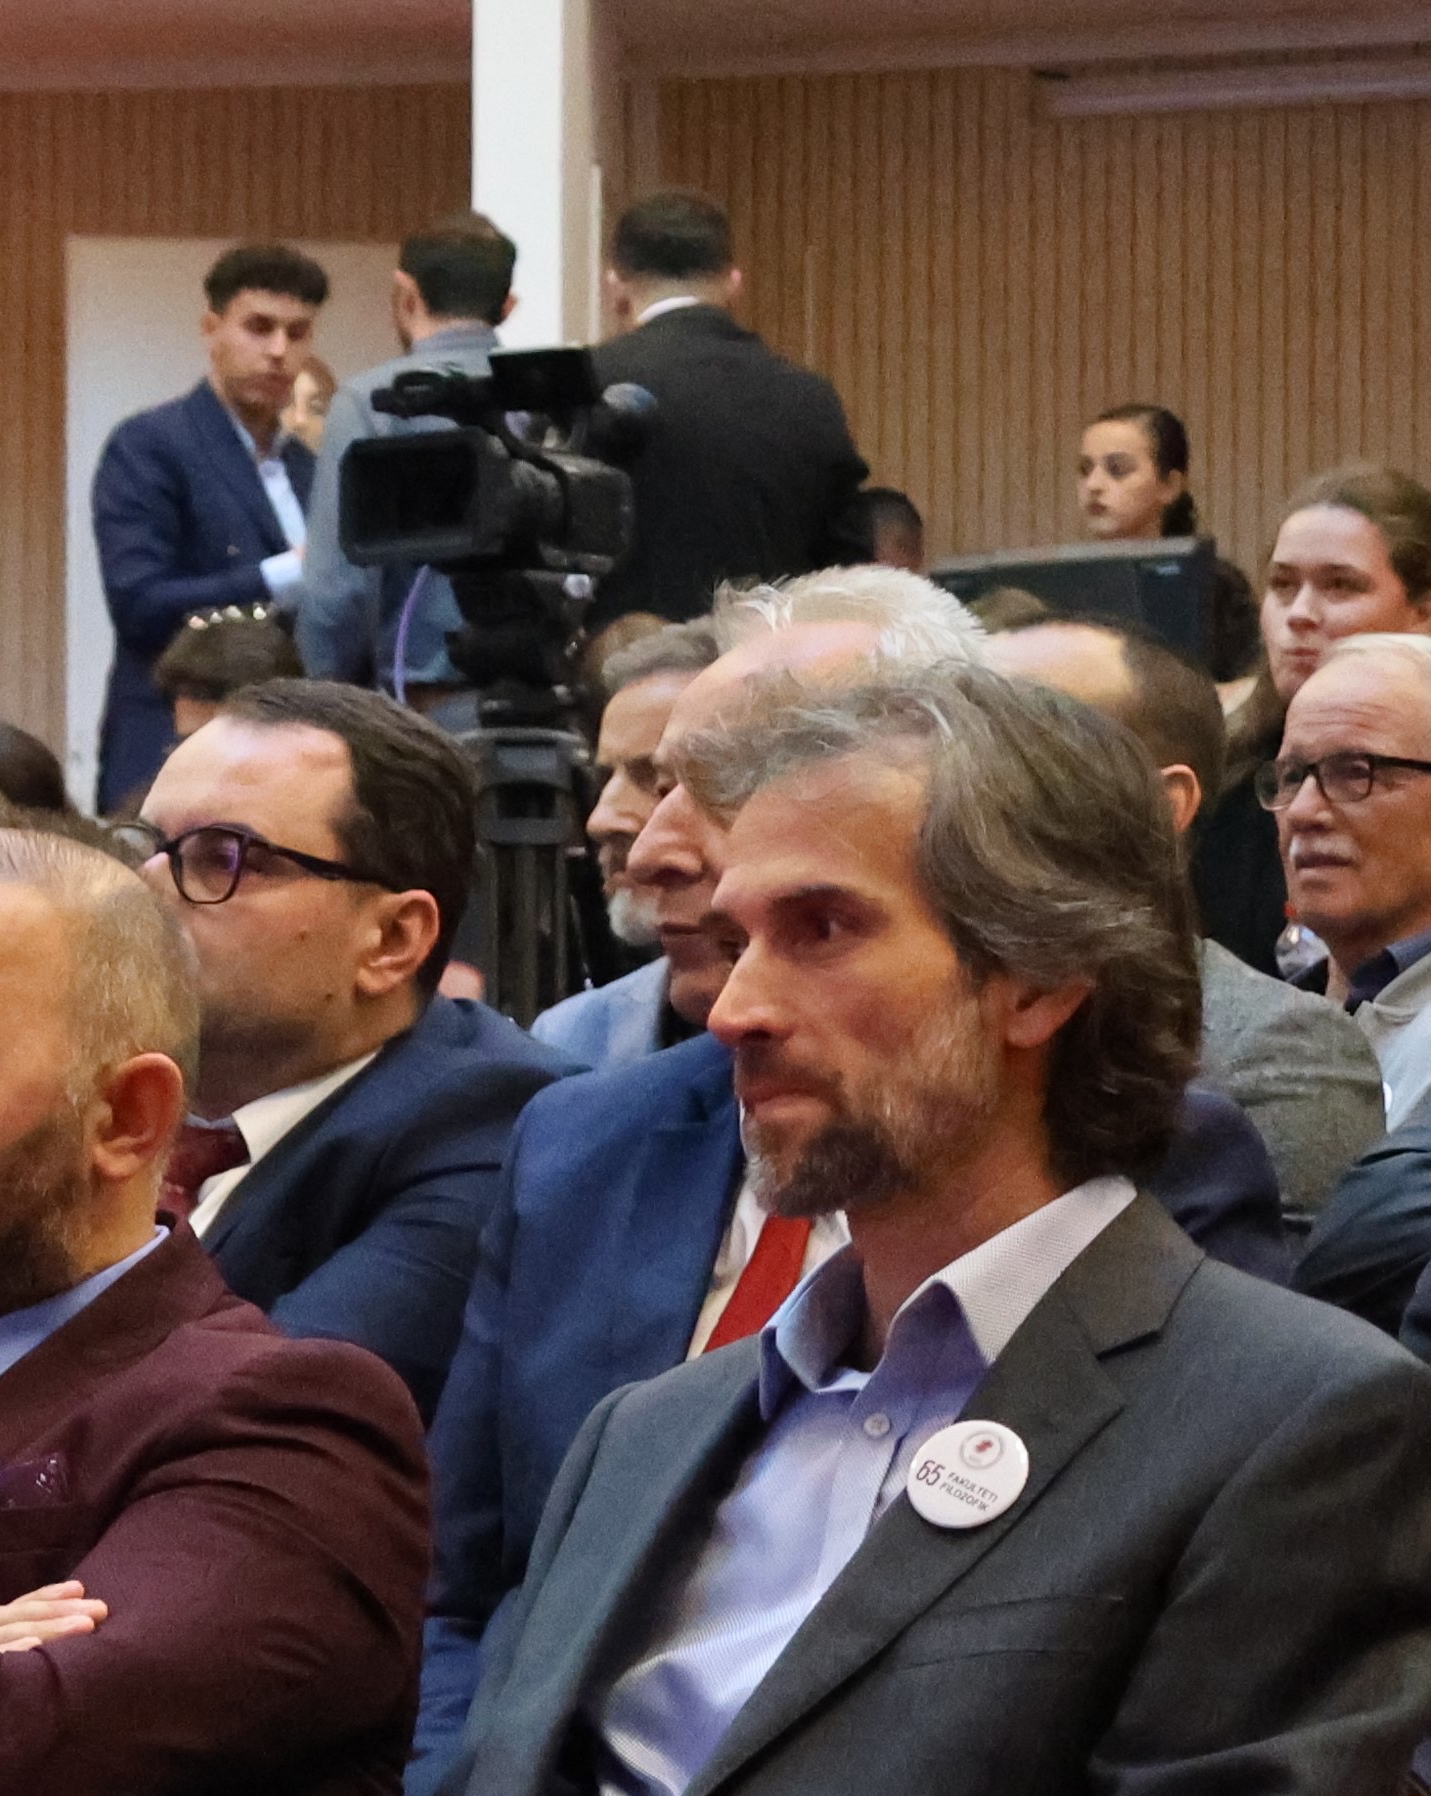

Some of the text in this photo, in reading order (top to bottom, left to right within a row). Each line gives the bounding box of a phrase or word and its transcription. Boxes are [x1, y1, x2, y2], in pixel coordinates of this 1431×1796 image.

[916, 1460, 945, 1486] 65
[947, 1472, 998, 1502] FAKULTETI
[939, 1482, 989, 1511] FILOZOFIK
